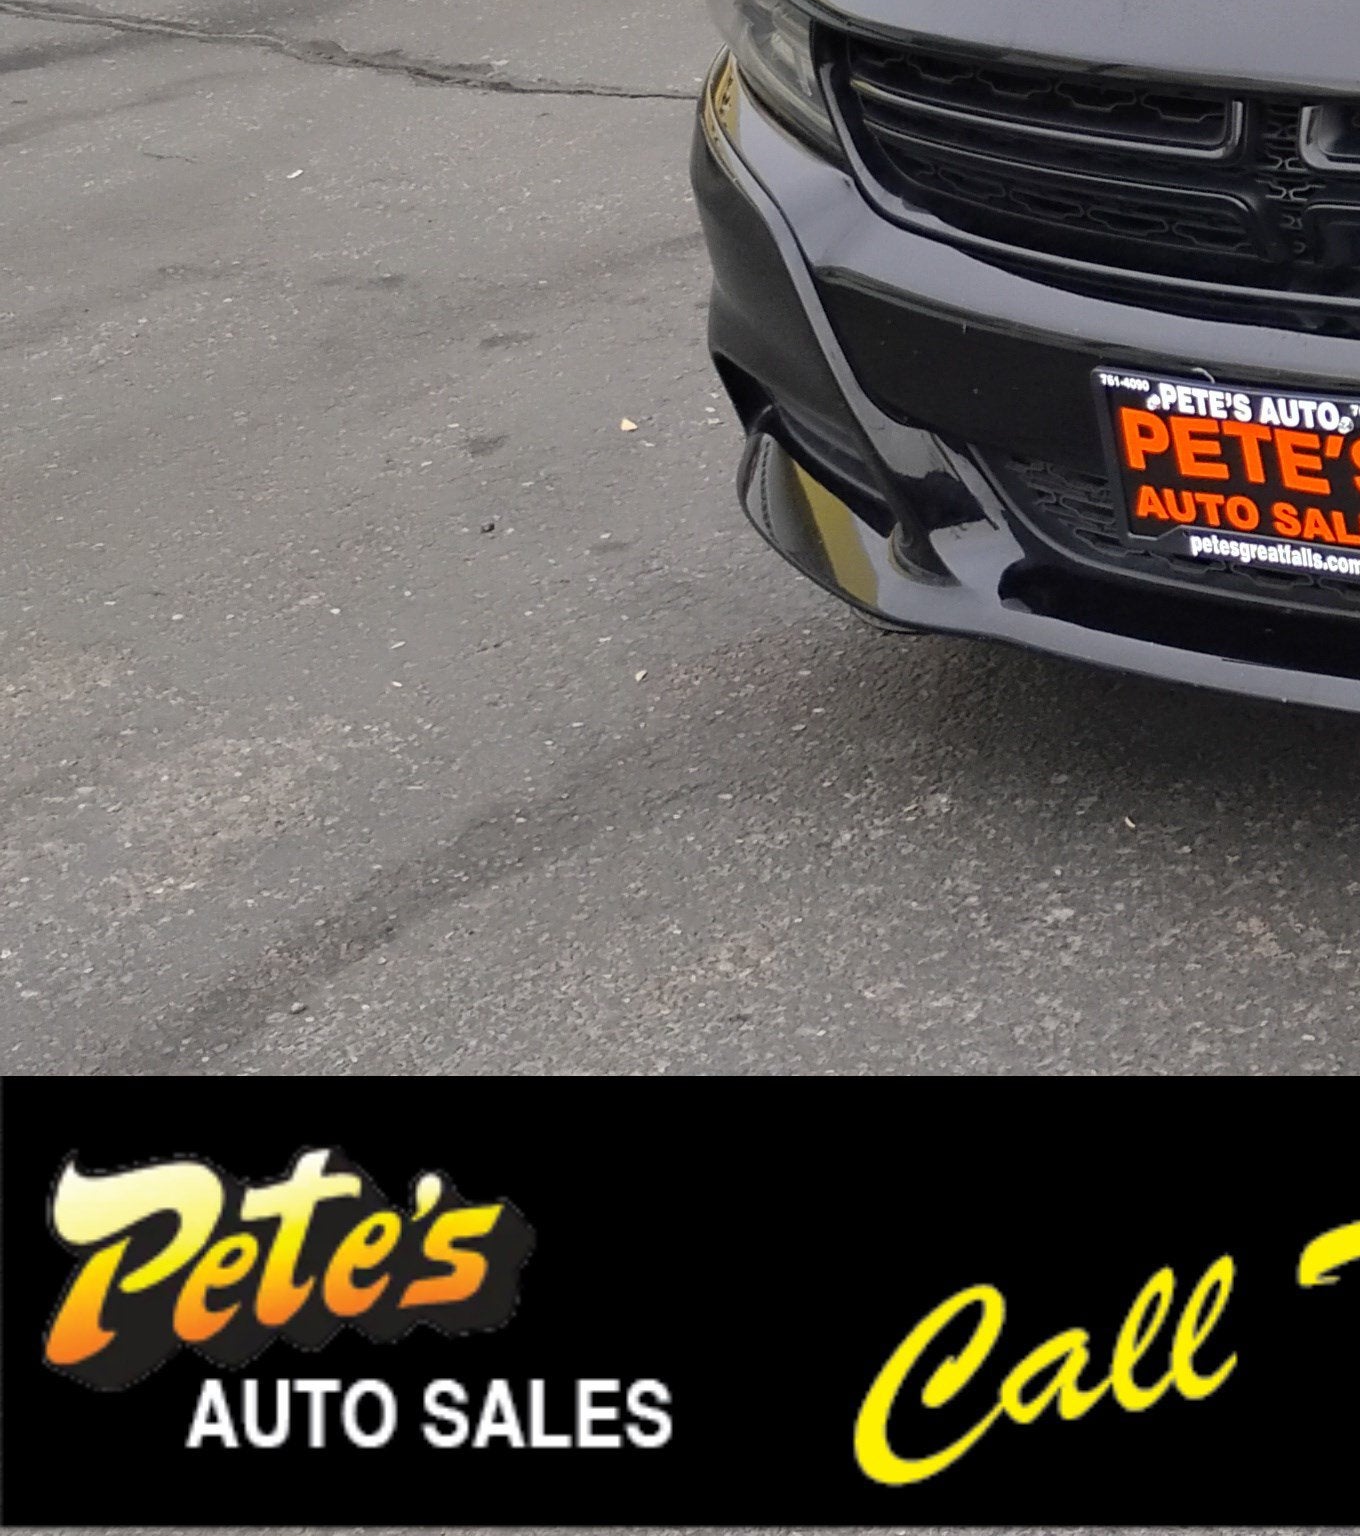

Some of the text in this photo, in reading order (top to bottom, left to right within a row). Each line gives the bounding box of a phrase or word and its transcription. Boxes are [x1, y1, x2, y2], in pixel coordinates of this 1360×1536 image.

[1158, 382, 1340, 431] PETE'S AUTO
[1137, 485, 1260, 531] AUTO
